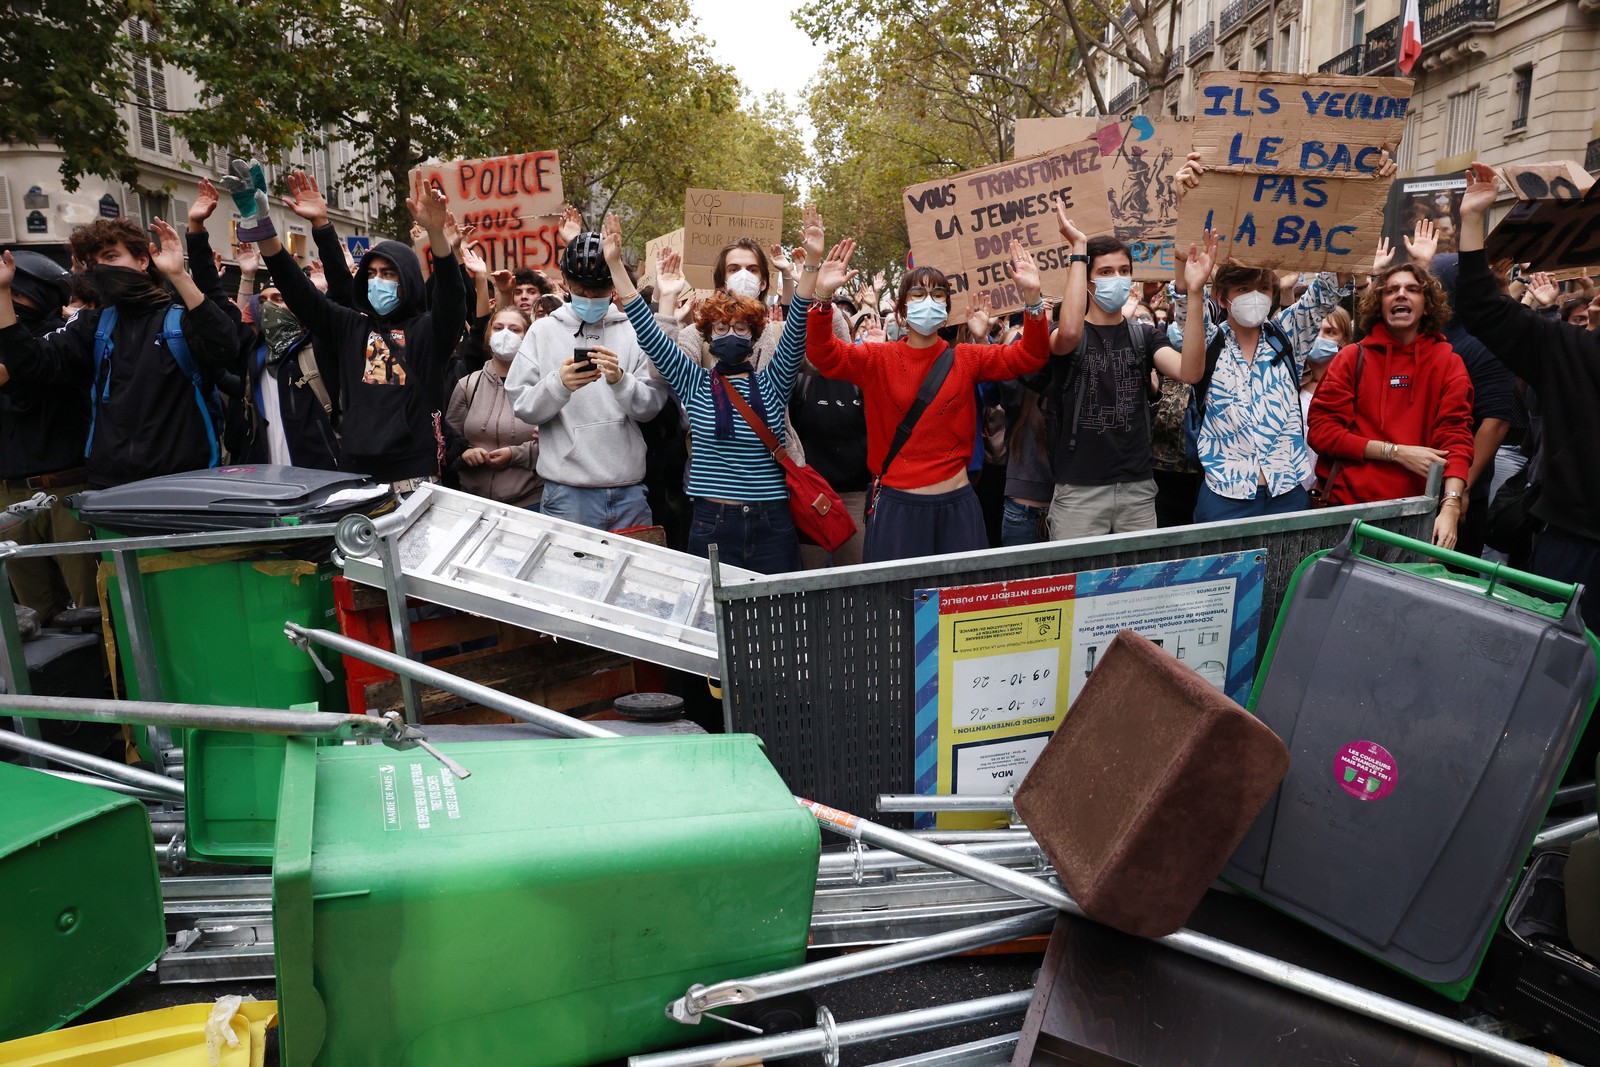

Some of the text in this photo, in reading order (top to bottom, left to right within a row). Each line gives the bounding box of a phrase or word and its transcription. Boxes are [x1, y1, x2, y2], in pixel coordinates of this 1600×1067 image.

[1204, 86, 1281, 116] ILS
[1228, 132, 1383, 173] LE BAC
[460, 155, 553, 196] POLICE
[908, 146, 1101, 214] VOUS TRANSFORMEZ
[1252, 174, 1328, 208] PAS
[690, 193, 722, 208] VOS
[464, 207, 524, 230] NOUS
[692, 213, 724, 227] ONT
[935, 186, 1074, 240] LA JEUNESSE
[692, 232, 723, 246] POUR
[1272, 215, 1359, 255] BAC
[942, 597, 973, 606] PUBLIC
[991, 590, 1029, 600] INTERDIT
[958, 721, 1020, 734] D'INTERVENTION
[1023, 716, 1055, 725] PÉRIODE
[1341, 756, 1356, 766] MAIS
[1356, 763, 1368, 771] PAS
[1352, 756, 1385, 772] CHANGENT
[1360, 753, 1391, 770] COULEURS
[992, 770, 1013, 778] MDA
[384, 776, 397, 824] MAIRIE DE PARIS
